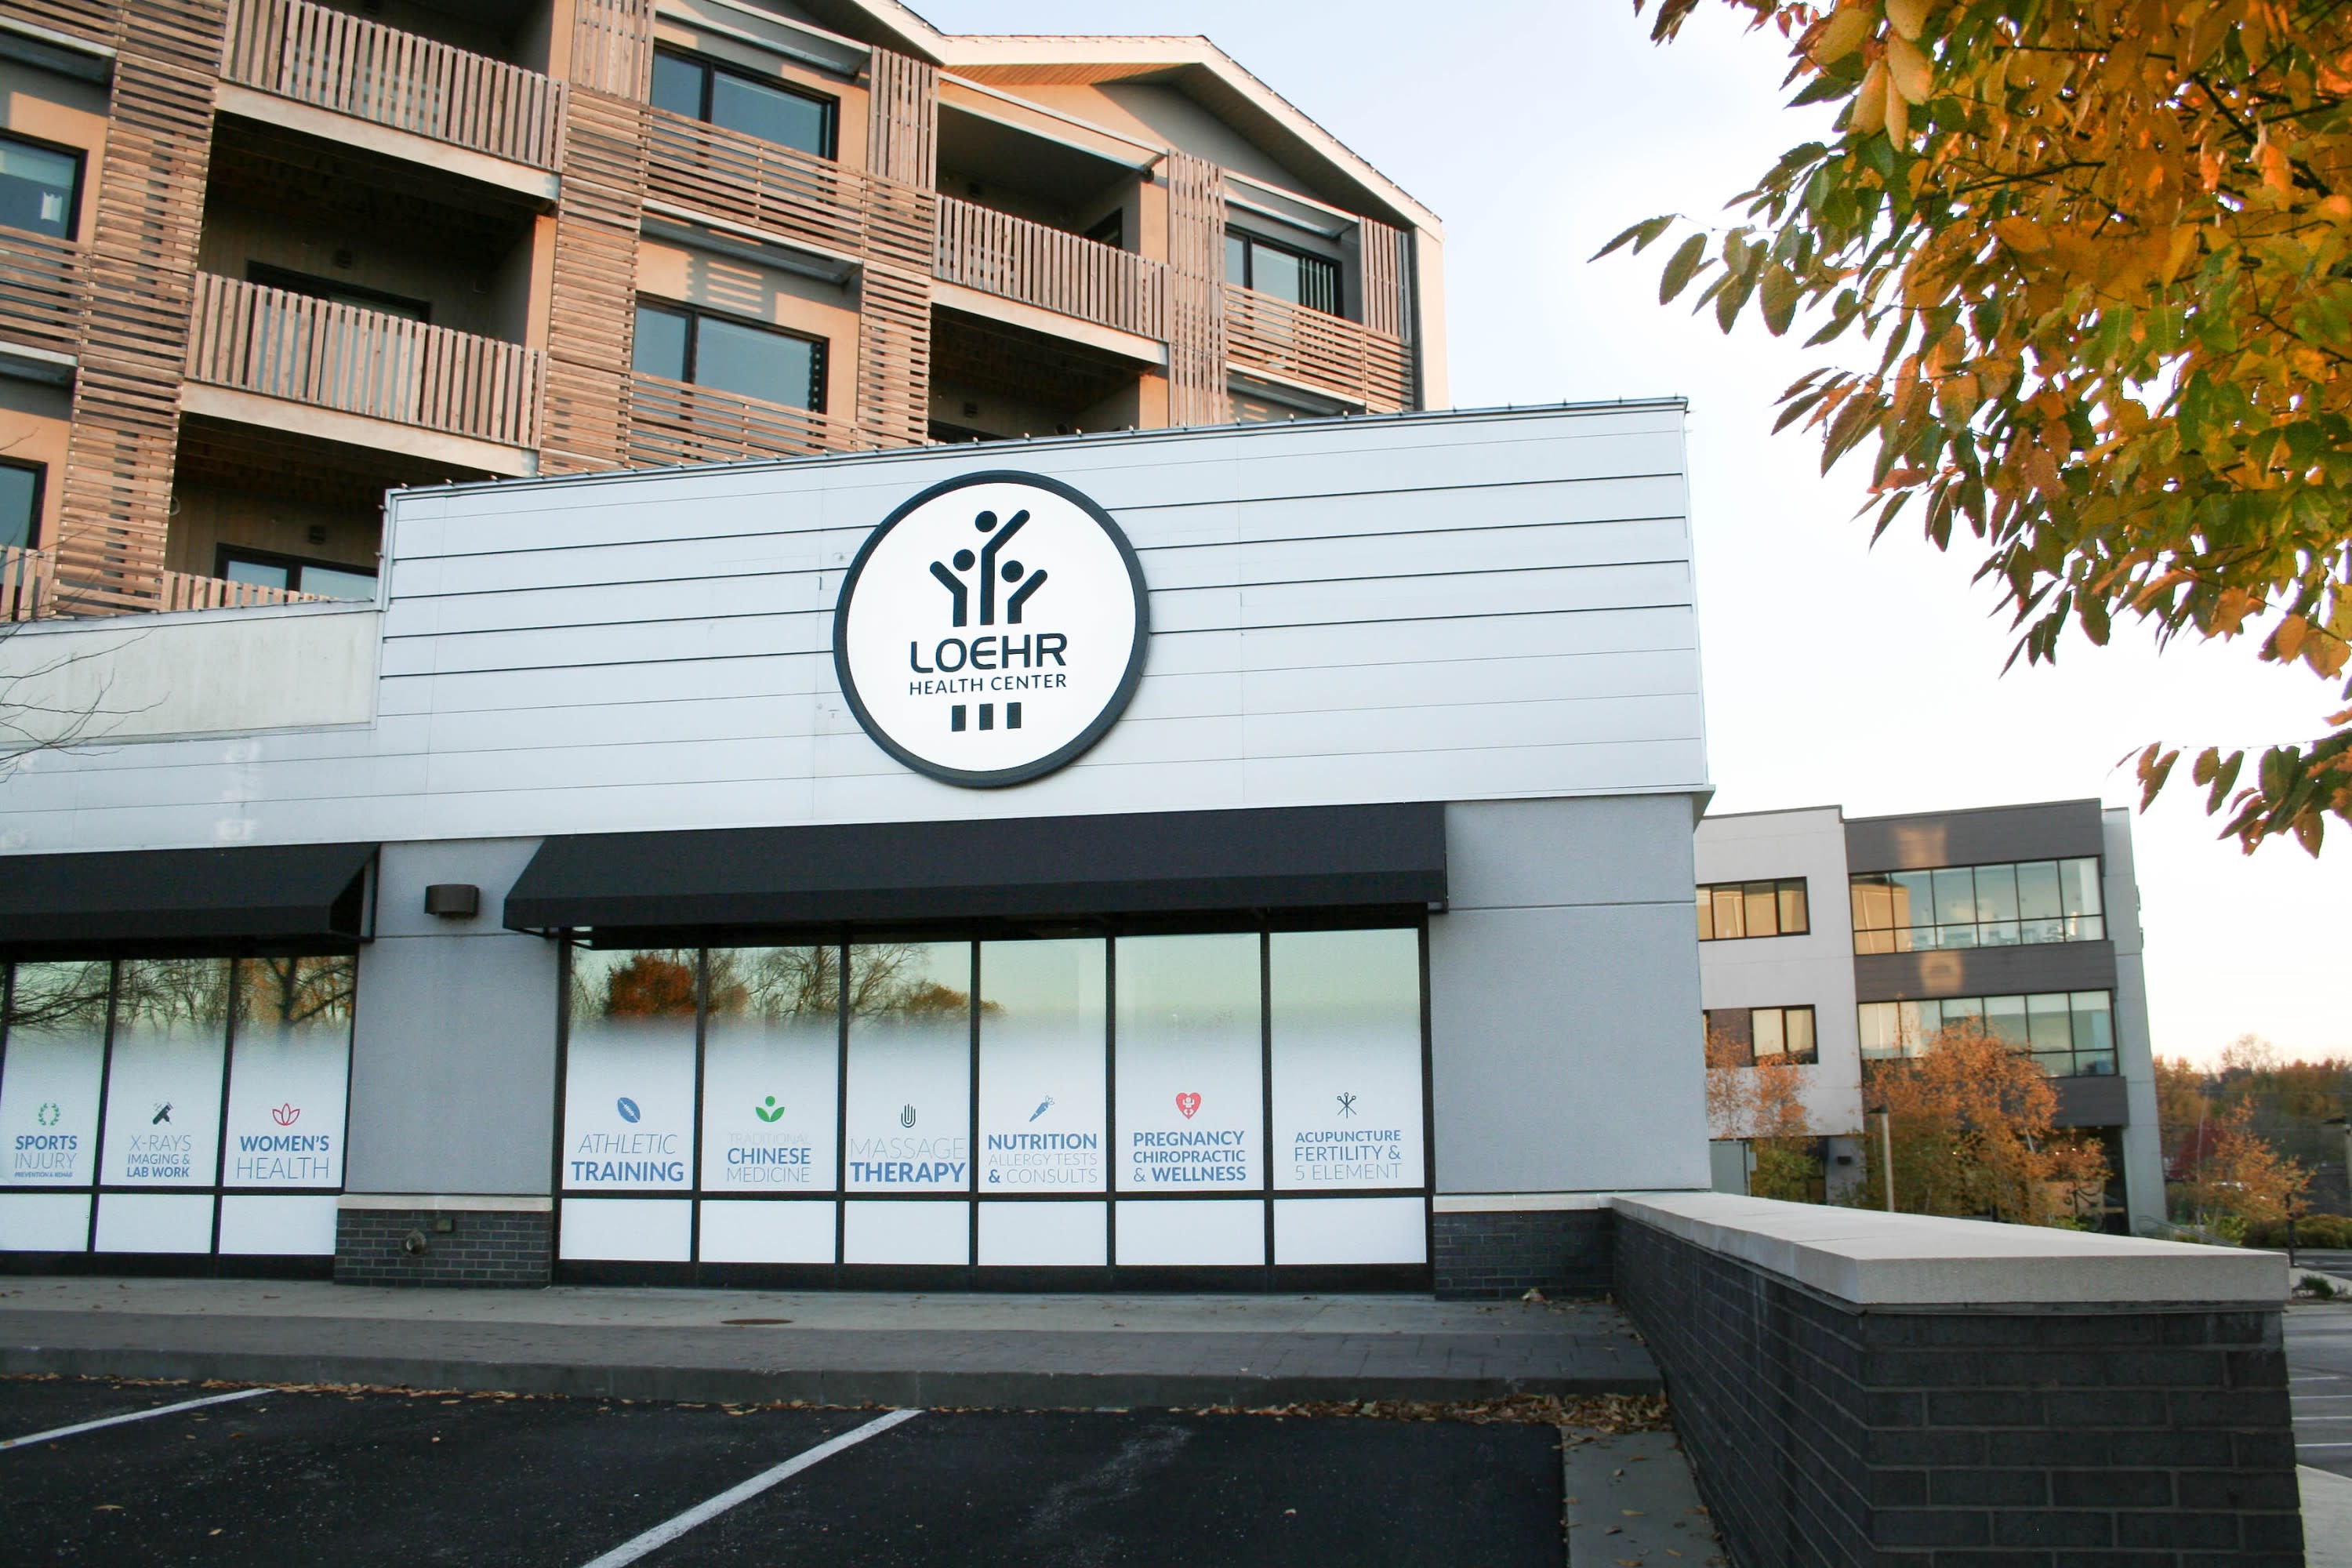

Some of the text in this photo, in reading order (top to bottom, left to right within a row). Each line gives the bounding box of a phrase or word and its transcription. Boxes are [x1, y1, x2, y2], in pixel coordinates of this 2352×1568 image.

[910, 633, 1068, 673] LOEHR
[909, 673, 1067, 695] HEALTH CENTER
[15, 1135, 78, 1150] SPORTS
[129, 1134, 191, 1152] X-RAYS
[240, 1135, 330, 1152] WOMEN'S
[578, 1134, 677, 1155] ATHLETIC
[988, 1134, 1098, 1150] NUTRITION
[1134, 1131, 1244, 1147] PREGNANCY
[1295, 1130, 1402, 1143] ACUPUNCTURE
[728, 1148, 811, 1164] CHINESE
[851, 1138, 966, 1160] MASSAGE
[1134, 1150, 1246, 1163] CHIROPRACTIC
[1295, 1145, 1402, 1161] FERTILITY &
[14, 1152, 77, 1169] INJURY
[128, 1154, 191, 1166] IMAGING &
[989, 1153, 1098, 1166] ALLERGY TESTS
[126, 1167, 190, 1178] LAB WORK
[237, 1157, 329, 1179] HEALTH
[571, 1161, 684, 1182] TRAINING
[727, 1167, 811, 1183] MEDICINE
[850, 1162, 967, 1183] THERAPY
[989, 1168, 1097, 1183] & CONSULTS
[1134, 1166, 1247, 1182] & WELLNESS
[1295, 1163, 1403, 1181] 5 ELEMENT
